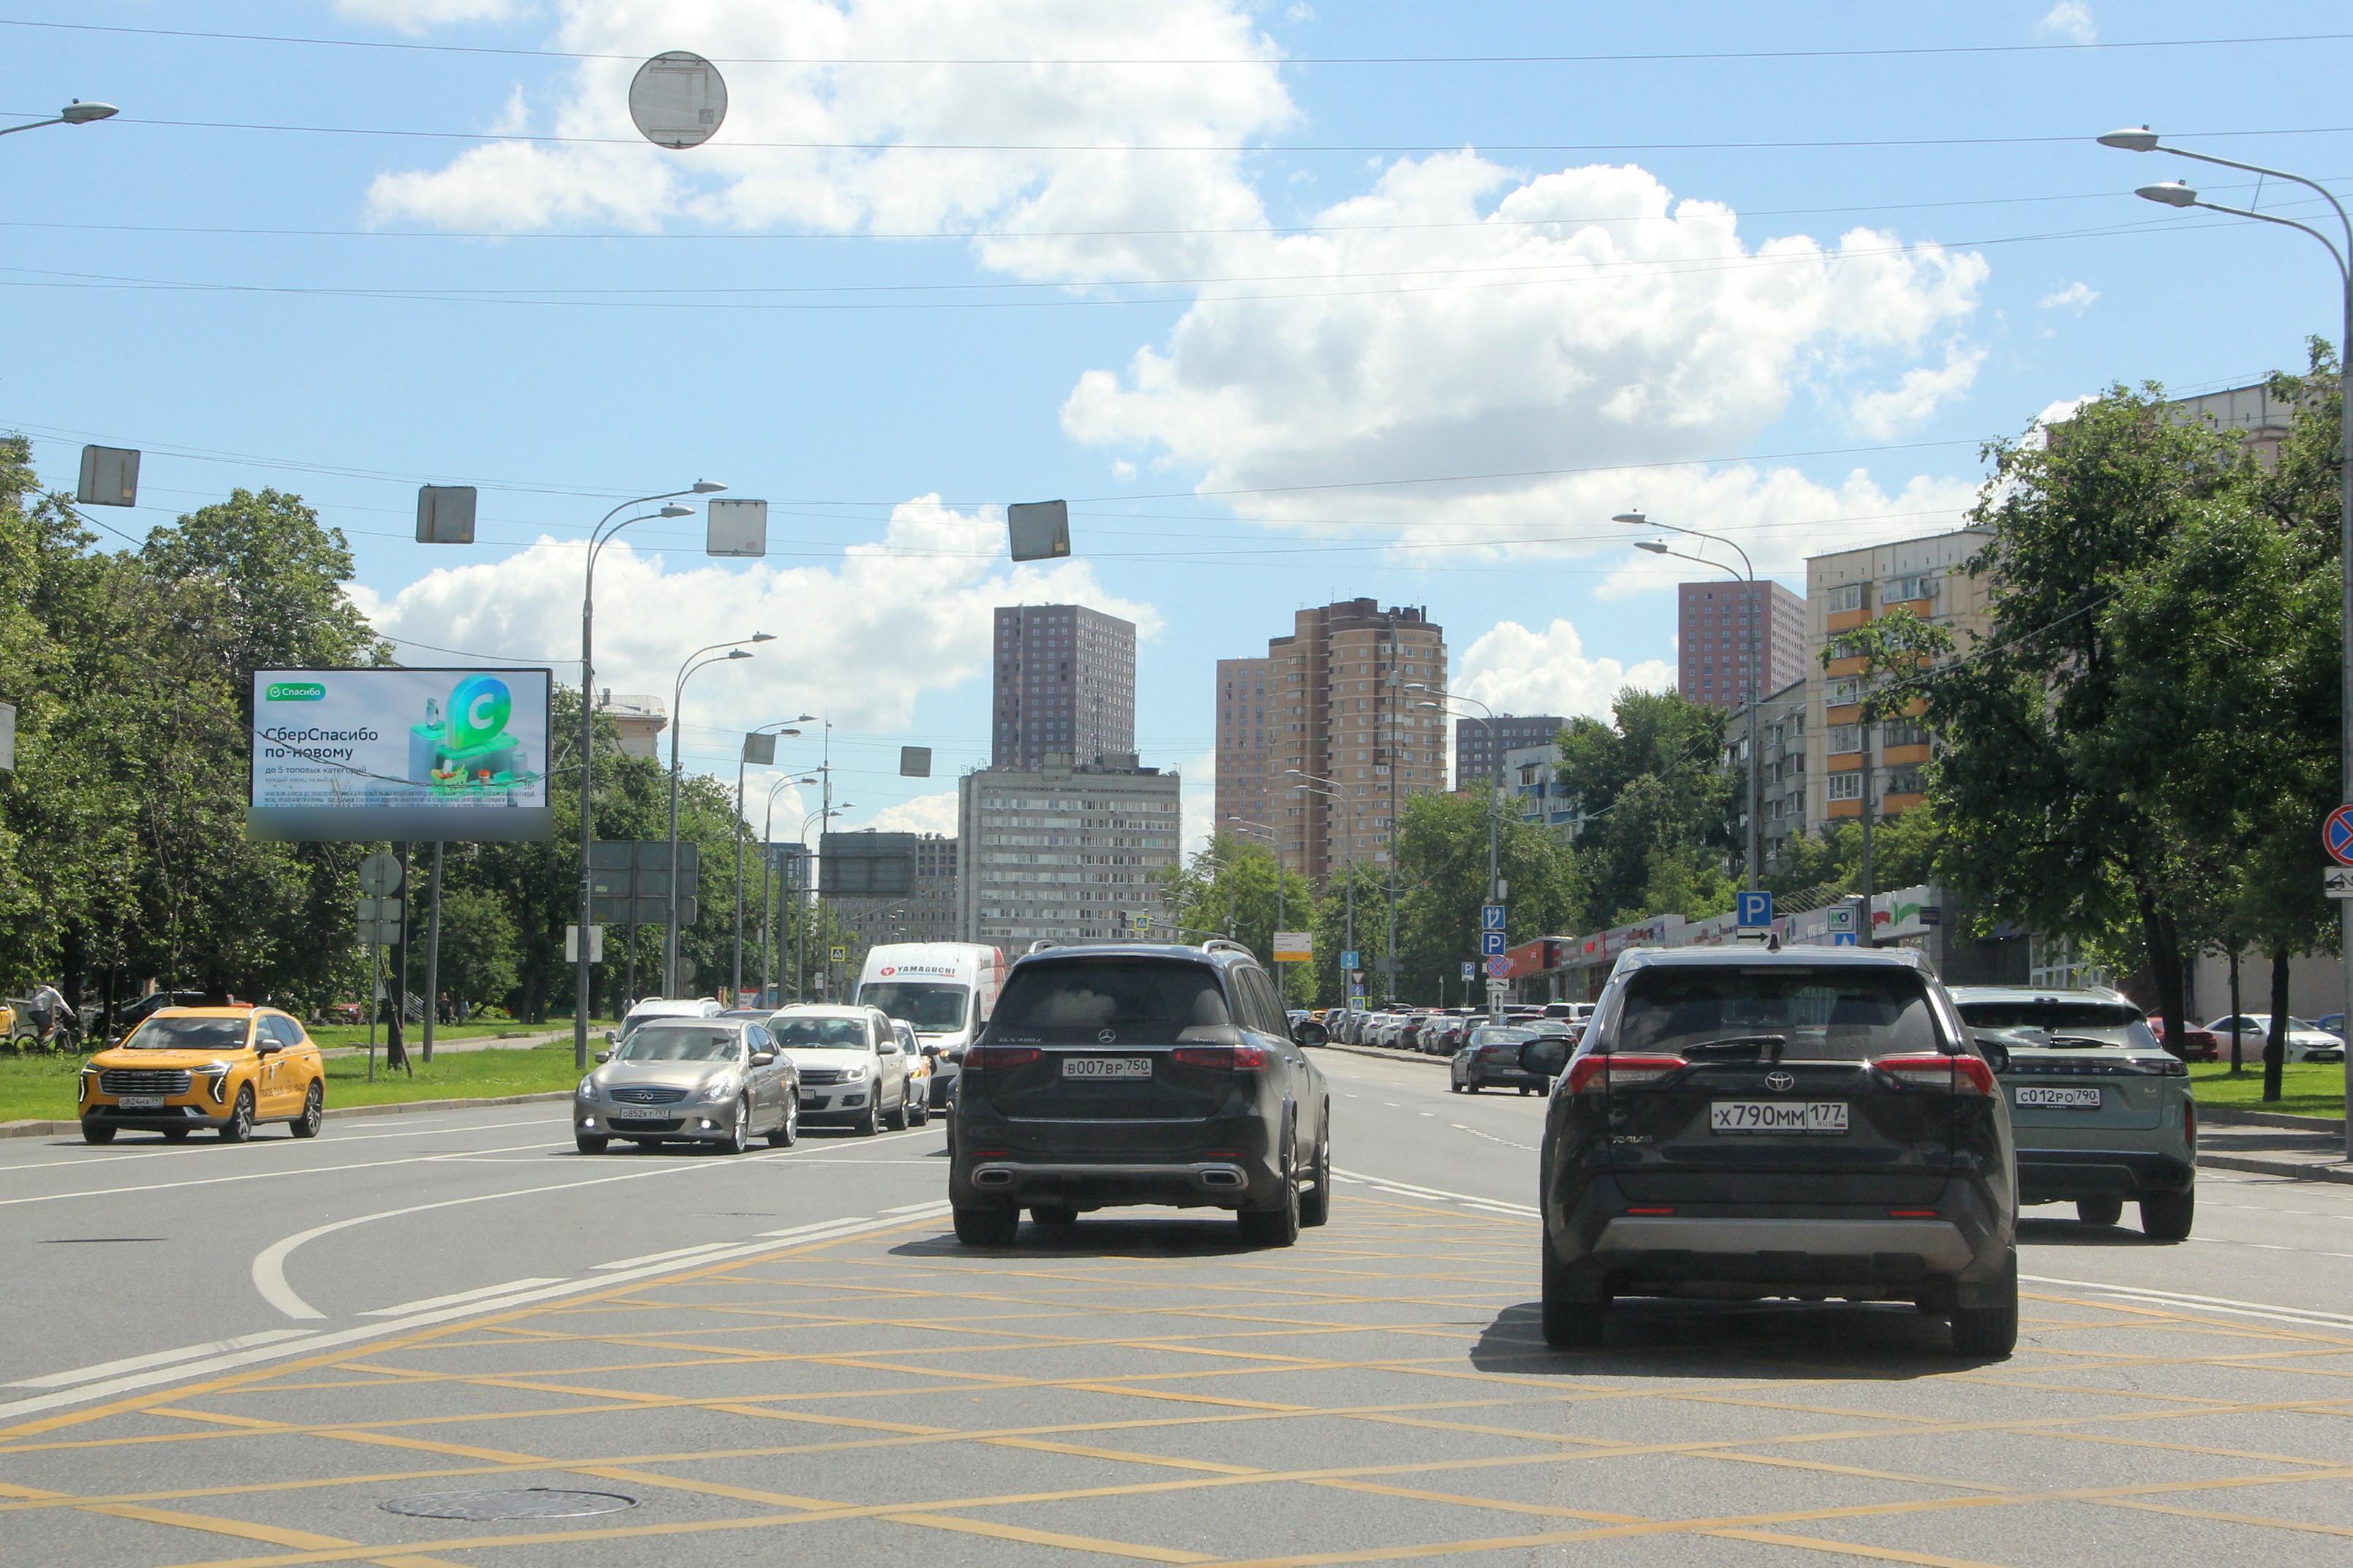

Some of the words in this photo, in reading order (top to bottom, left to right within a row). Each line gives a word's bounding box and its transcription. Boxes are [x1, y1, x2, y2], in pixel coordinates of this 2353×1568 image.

[282, 688, 320, 696] Спасибо
[265, 727, 378, 743] СберСпасибо
[265, 748, 353, 760] по-новому
[323, 766, 366, 775] категорий
[1747, 896, 1765, 923] P
[1489, 936, 1501, 953] P
[898, 966, 955, 974] YAMAGUCHI
[1465, 964, 1473, 974] P
[1068, 1061, 1123, 1074] В007ВР
[1126, 1060, 1148, 1071] 750
[2020, 1090, 2074, 1103] С012РО
[2076, 1090, 2096, 1100] 790
[1719, 1105, 1805, 1126] Х790ММ
[1810, 1105, 1842, 1120] 177
